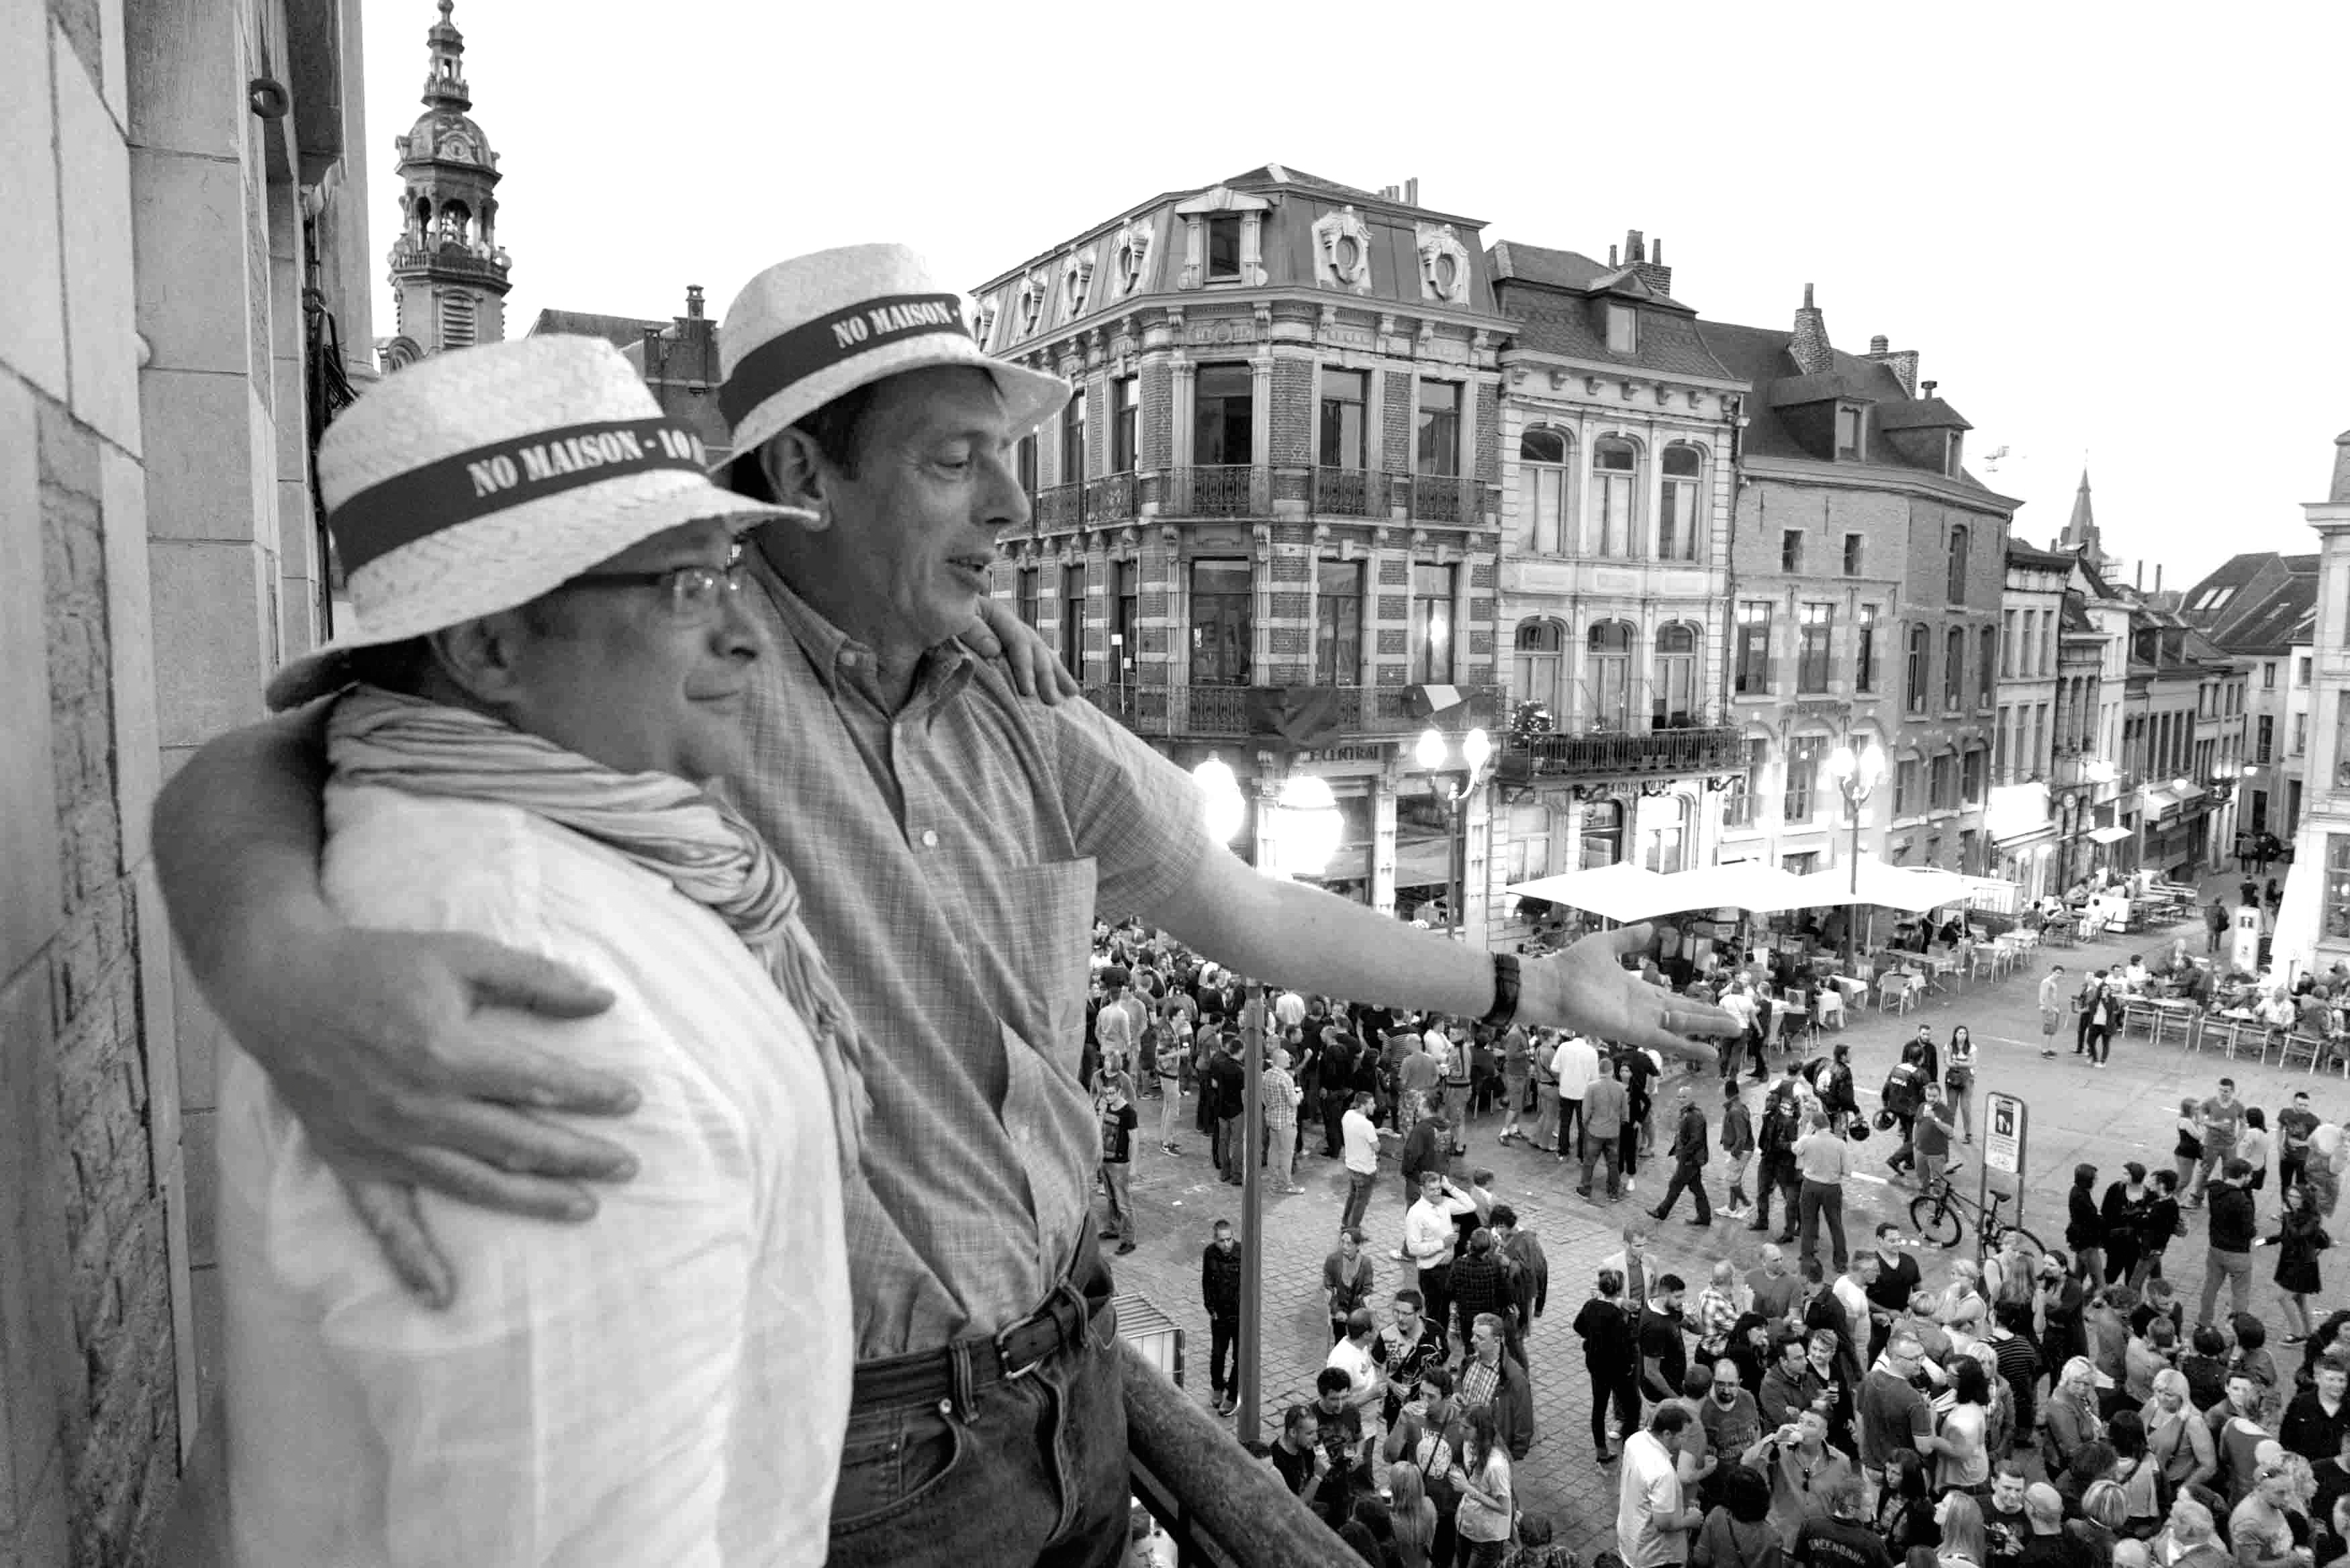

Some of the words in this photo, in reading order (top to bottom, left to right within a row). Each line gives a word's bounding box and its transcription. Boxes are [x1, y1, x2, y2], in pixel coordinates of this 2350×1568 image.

[831, 315, 869, 348] NO
[867, 301, 953, 334] MAISON
[467, 454, 518, 497] NO
[519, 430, 644, 481] MAISON
